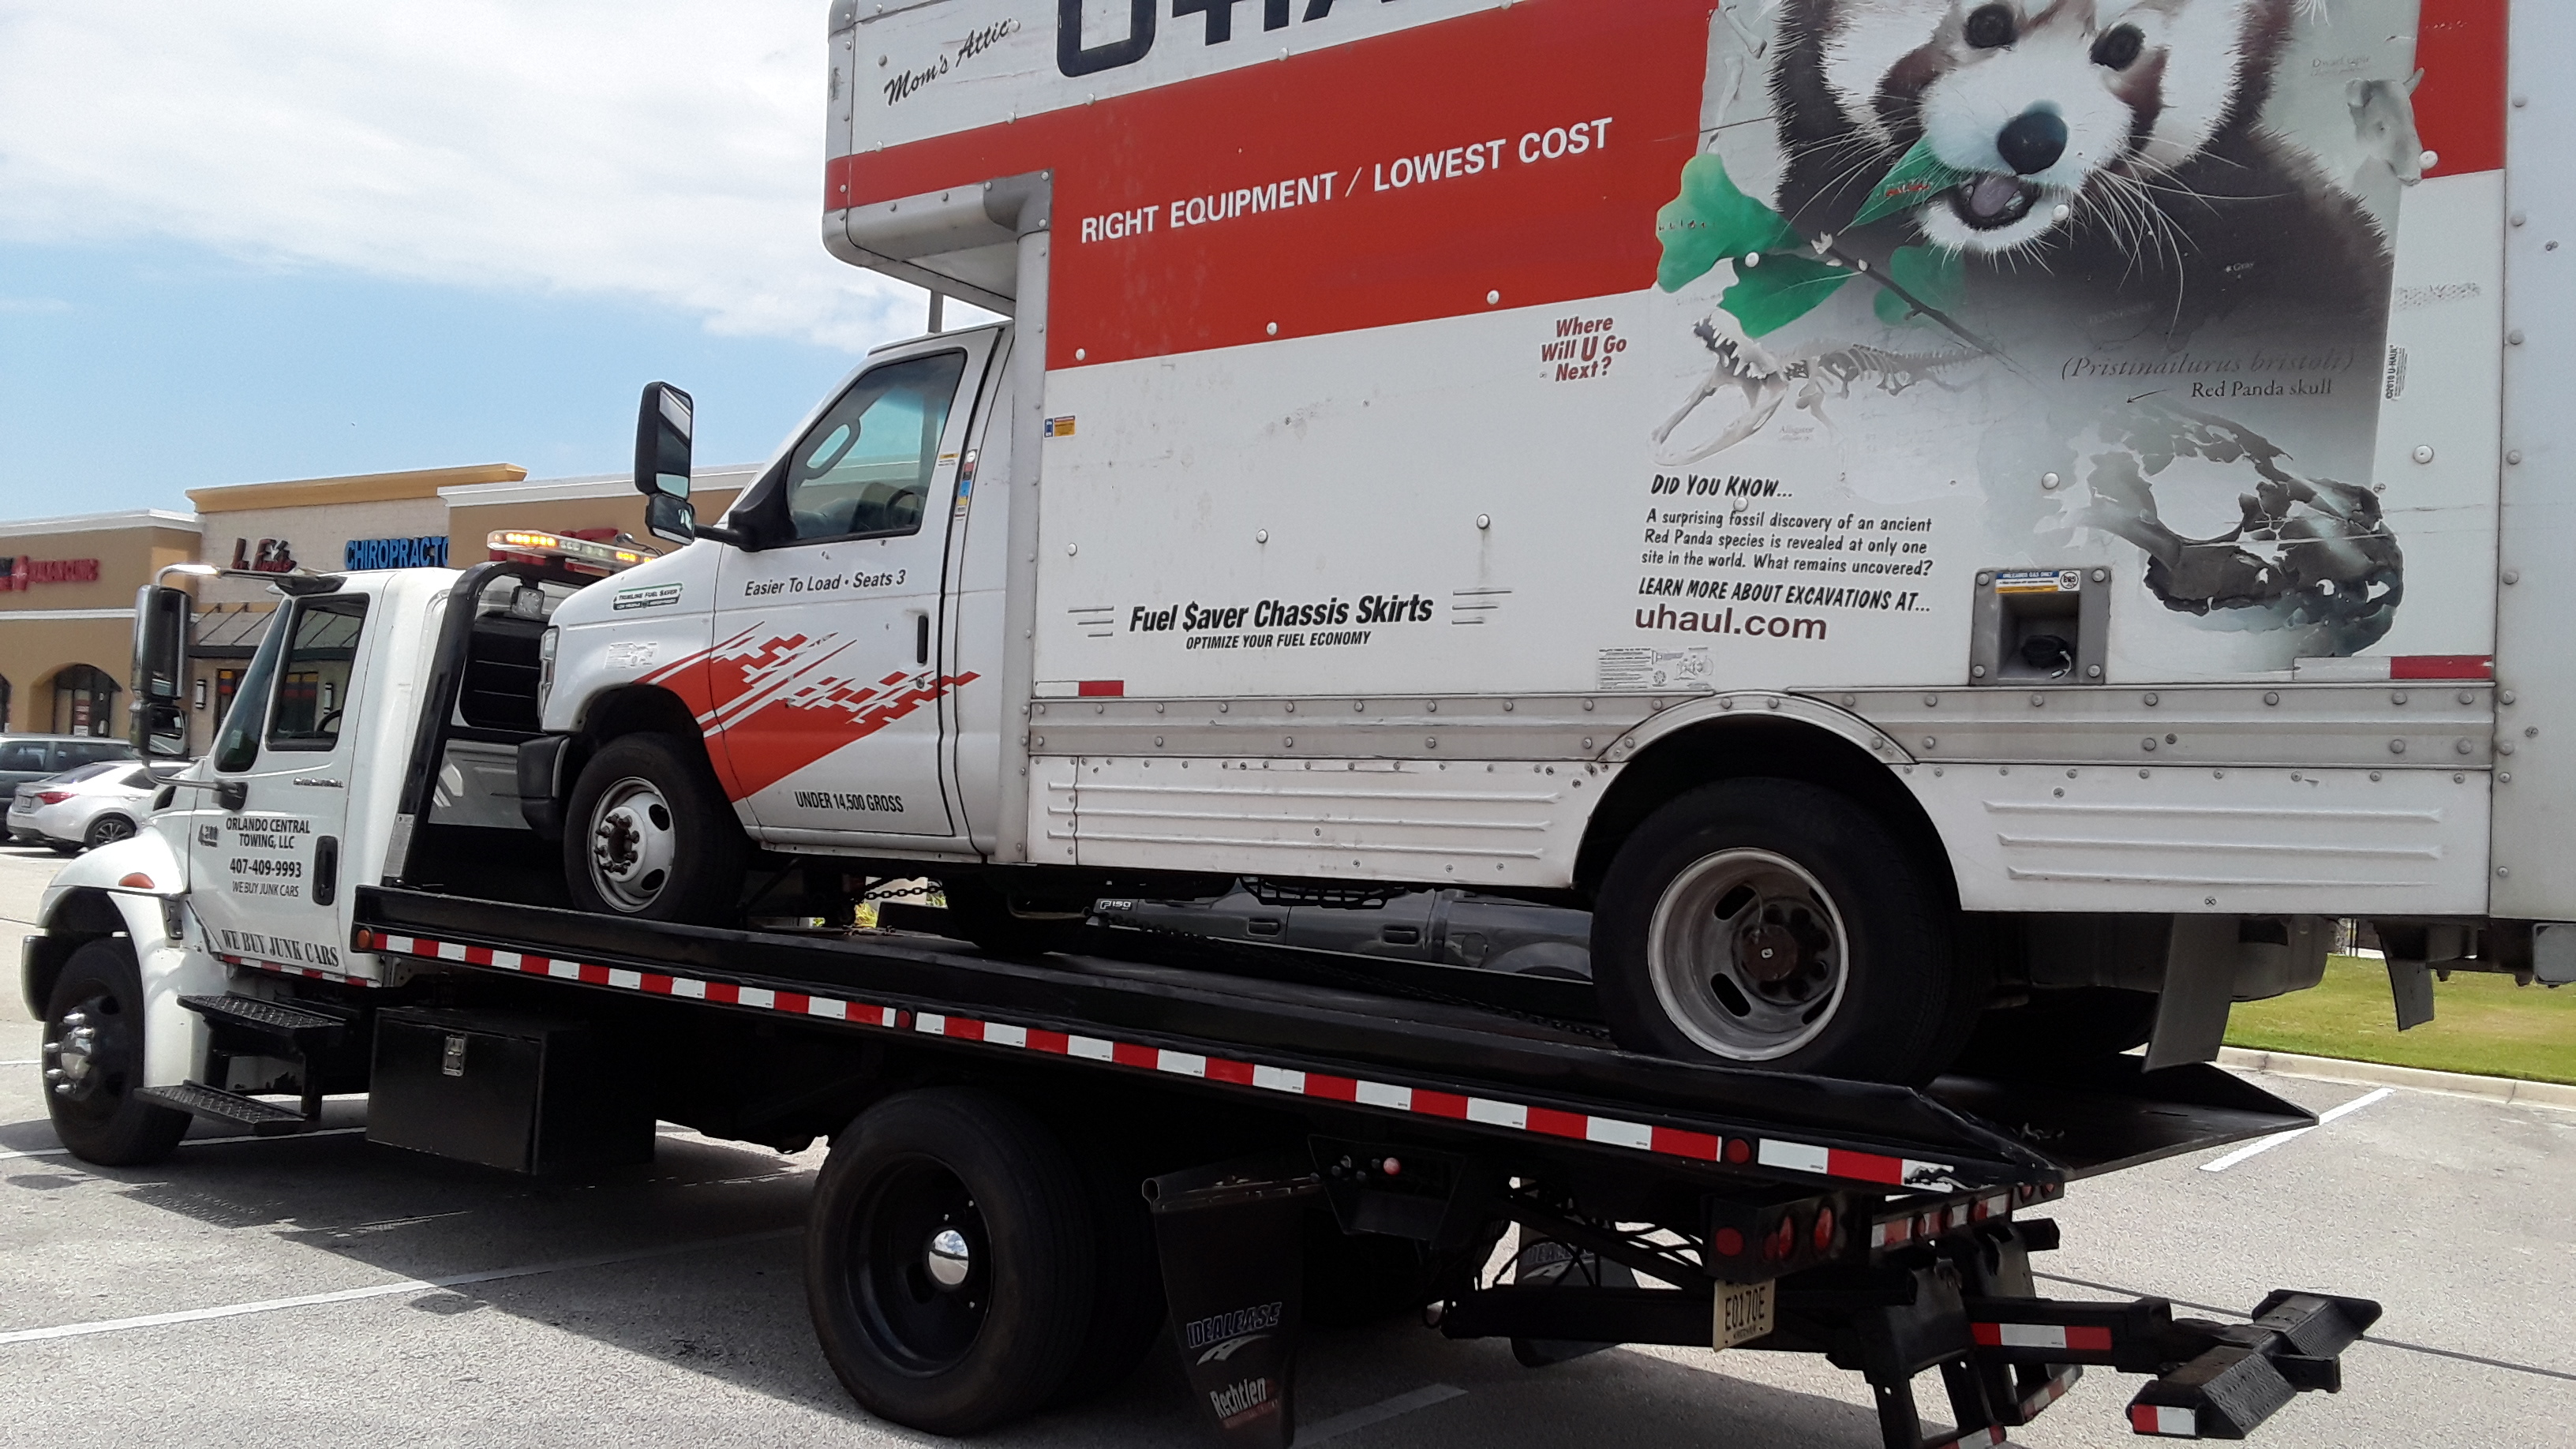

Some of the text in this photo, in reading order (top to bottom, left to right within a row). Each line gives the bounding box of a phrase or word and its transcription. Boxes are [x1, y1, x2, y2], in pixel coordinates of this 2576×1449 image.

[883, 54, 949, 106] Mom's
[956, 20, 1011, 68] Attic
[1081, 205, 1159, 243] RIGHT
[1170, 170, 1339, 229] EQUIPMENT
[1373, 139, 1506, 193] LOWEST
[1518, 117, 1612, 164] COST
[1556, 316, 1613, 337] Where
[1541, 335, 1627, 361] Will U Go
[1556, 356, 1612, 382] Next?
[2191, 377, 2331, 397] Red Panda skull
[1651, 474, 1793, 498] DID YOU KNOW...
[1646, 508, 1932, 532] A surprising fossil discovery of an ancient
[1644, 529, 1927, 557] Red Panda species is revealed at only one
[1641, 550, 1934, 576] site in the world. What remains uncovered?
[745, 569, 906, 596] Easier To Load Seats 3
[1638, 577, 1931, 612] LEARN MORE ABOUT EXCAVATIONS AT...
[1129, 593, 1435, 633] Fuel $aver Chassis Skirts
[1634, 604, 1828, 640] uhaul.com
[1186, 631, 1372, 650] OPTIMIZE YOUR FUEL ECONOMY
[794, 791, 904, 813] UNDER 14,500 GROSS
[226, 817, 311, 834] ORLANDO CENTRAL
[239, 833, 296, 849] TOWING, LLC
[229, 858, 302, 878] 407-409-9993
[232, 880, 300, 897] WE BUY JUNK CARS
[220, 929, 339, 967] WE BUY JUNK CARS
[1186, 1301, 1282, 1349] IDEALEASE
